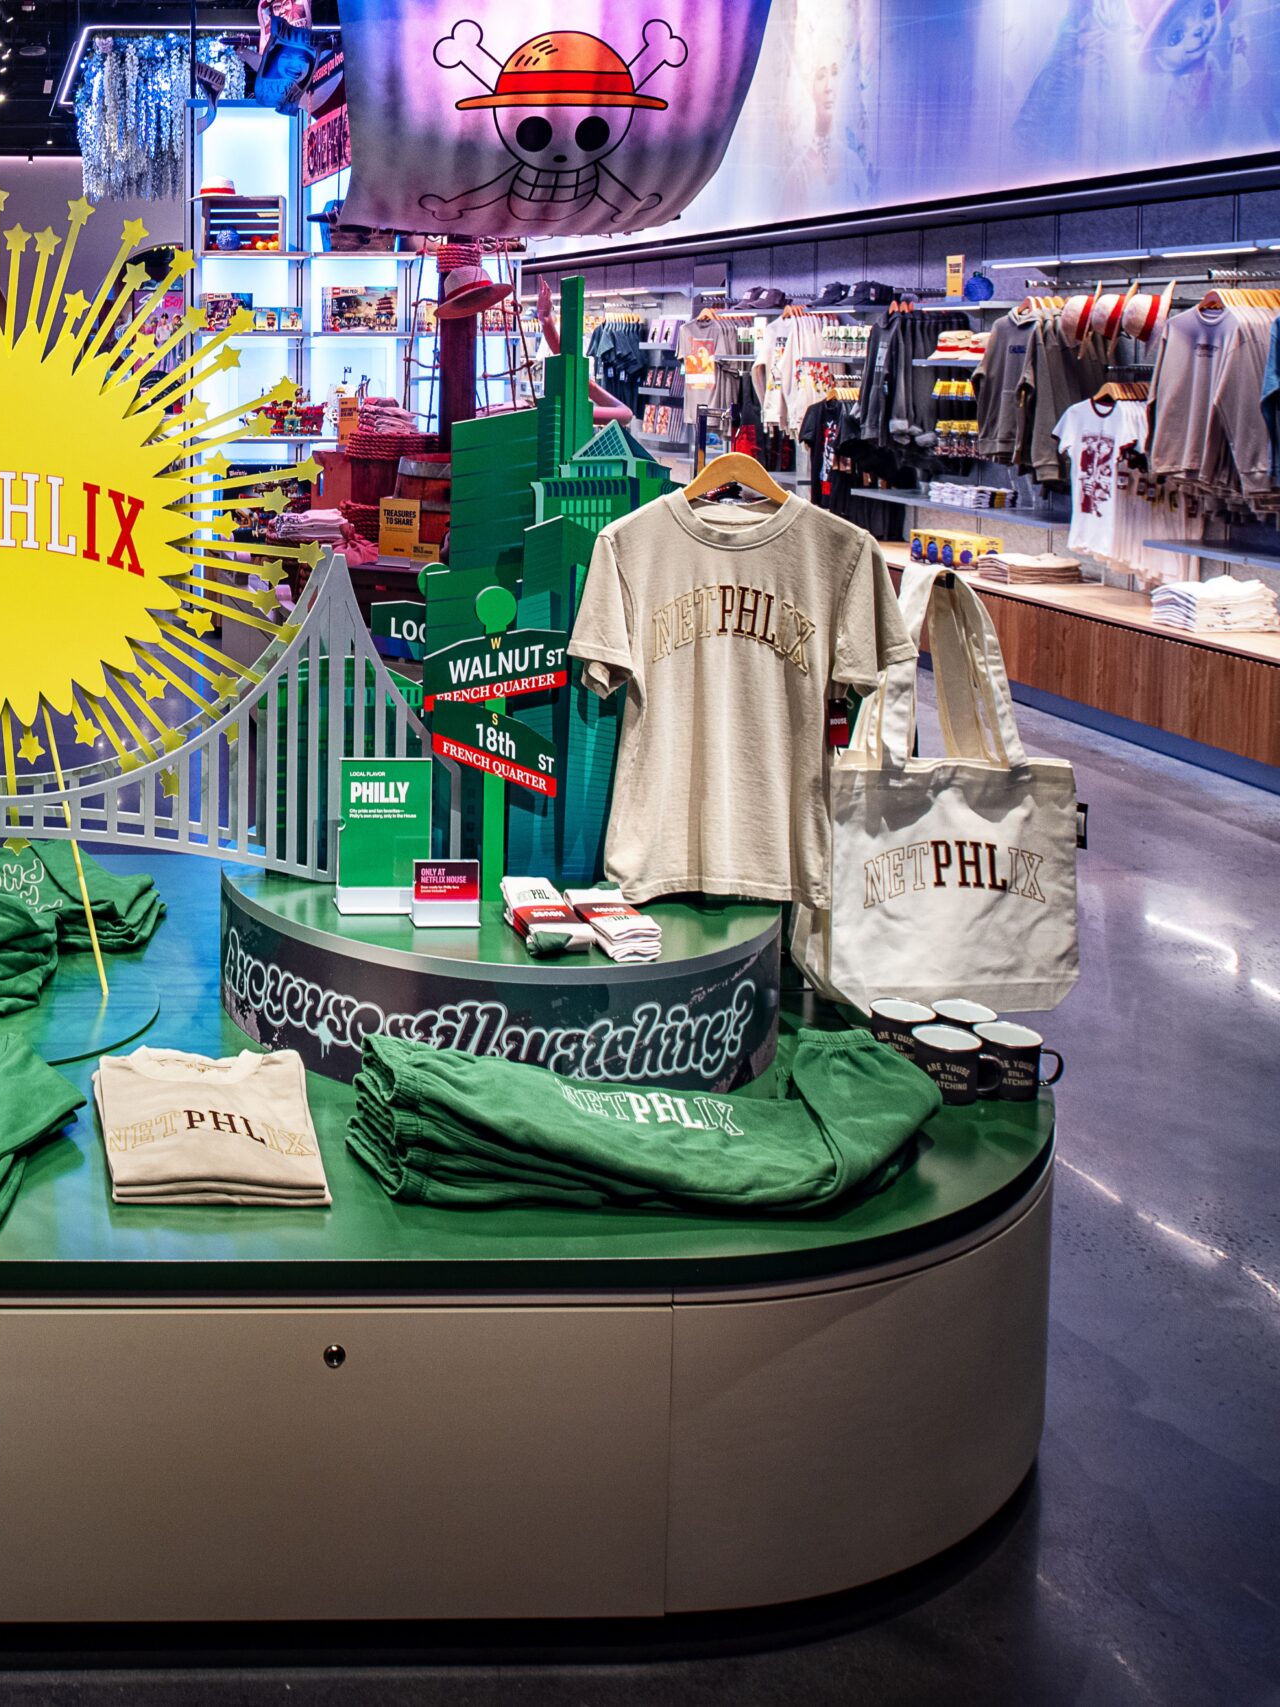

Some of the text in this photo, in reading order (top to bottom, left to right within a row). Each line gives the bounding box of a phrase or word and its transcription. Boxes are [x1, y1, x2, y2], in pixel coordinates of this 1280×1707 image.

[384, 508, 417, 518] TREASURES
[386, 517, 413, 526] TO SHARE
[490, 637, 502, 650] W
[448, 644, 565, 684] WALNUT ST
[436, 673, 556, 702] FRENCH QUARTER
[491, 713, 499, 726] S
[829, 717, 848, 726] HOUSE
[475, 723, 516, 760] 18th
[442, 741, 547, 791] FRENCH QUARTER
[538, 753, 555, 773] ST
[349, 781, 410, 804] PHILLY
[420, 868, 446, 876] ONLY AT
[420, 876, 467, 884] NETFLIX HOUSE
[863, 840, 1045, 909] NETPHLIX
[503, 979, 756, 1081] watching?
[876, 1030, 914, 1047] ARE YOUSE
[927, 1062, 970, 1078] ARE YOUSE
[939, 1073, 958, 1082] STILL
[1007, 1070, 1025, 1078] STILL
[936, 1080, 968, 1091] ATCHING
[1002, 1078, 1033, 1087] ATCHING
[554, 1077, 744, 1136] NETPHLIX
[107, 1109, 316, 1157] NETPHLIX
